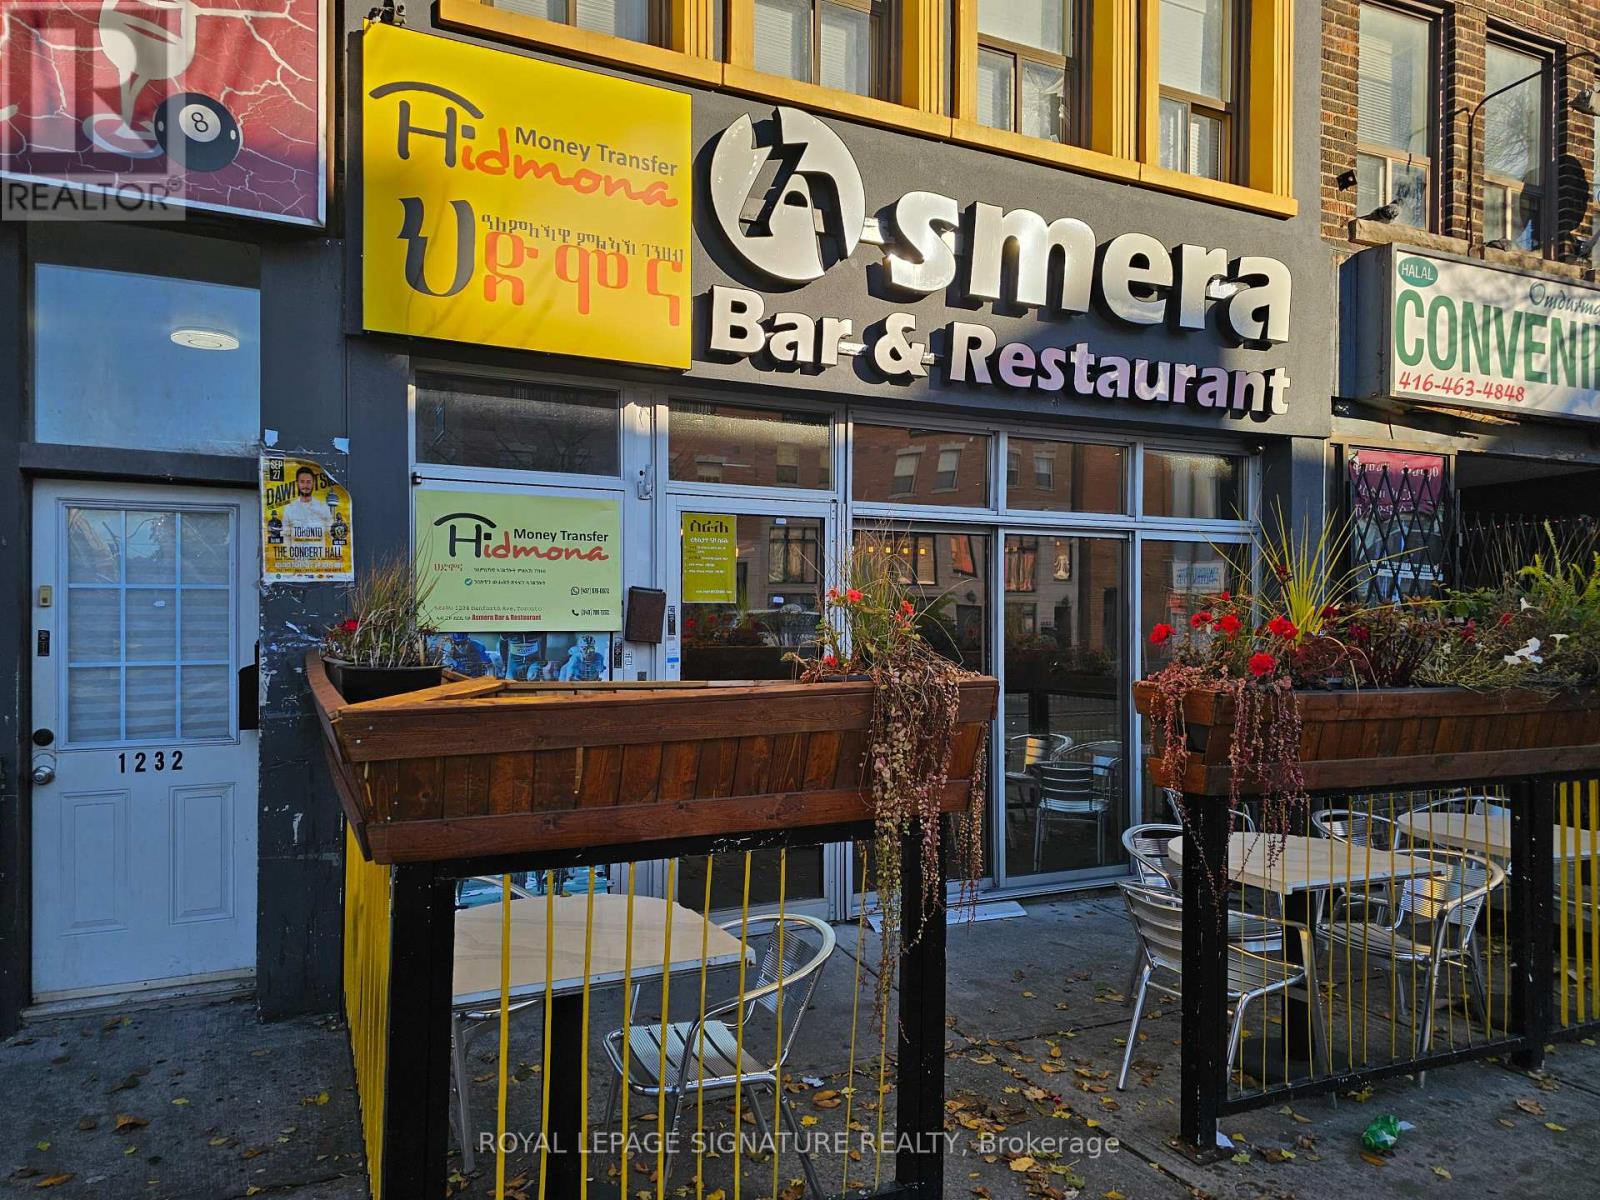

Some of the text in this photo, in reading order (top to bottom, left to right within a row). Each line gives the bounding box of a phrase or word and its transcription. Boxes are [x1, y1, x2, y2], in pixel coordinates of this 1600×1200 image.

[397, 98, 679, 207] Hidmona
[515, 127, 679, 177] Money Transfer
[712, 107, 1293, 345] Asmera
[1401, 261, 1434, 282] HALAL
[710, 285, 1292, 416] Bar & Restaurant
[1395, 288, 1600, 392] CONVENI
[1398, 371, 1526, 402] 416-463-4848
[270, 460, 283, 470] SEP
[273, 470, 281, 480] 27
[266, 480, 300, 506] DAWI
[294, 526, 323, 538] TORONTO
[448, 523, 609, 562] Hidmona
[513, 528, 609, 543] Money Transfer
[274, 546, 342, 559] THE CONCERT HALL
[118, 750, 183, 773] 1232
